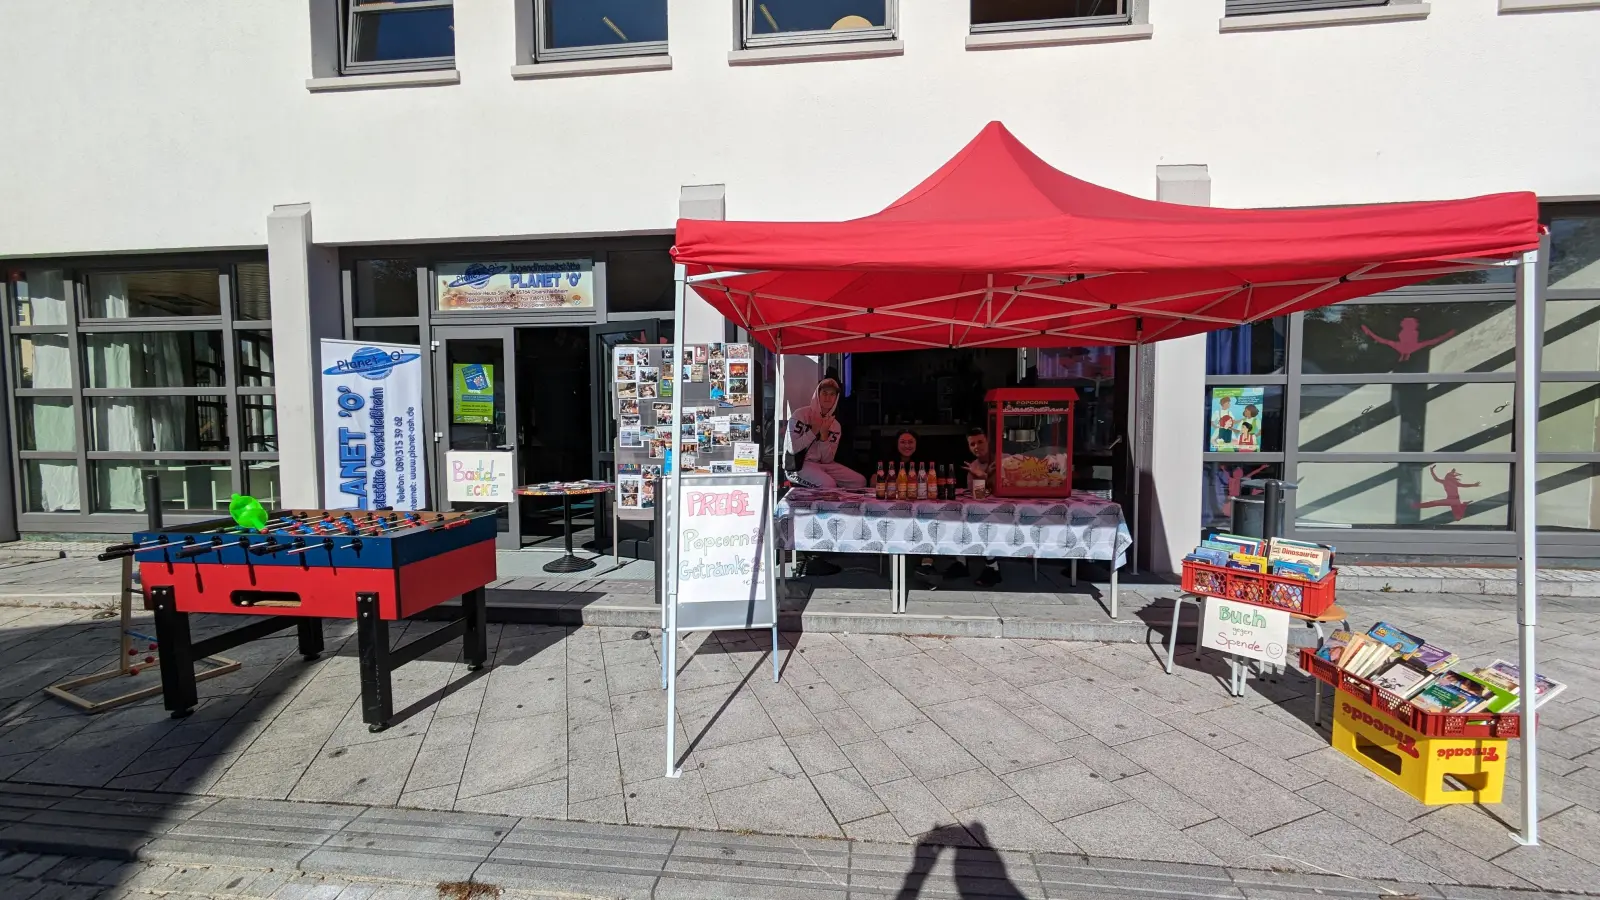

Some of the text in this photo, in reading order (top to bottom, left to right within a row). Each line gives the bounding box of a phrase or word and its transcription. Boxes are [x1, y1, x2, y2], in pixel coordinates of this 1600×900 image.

[509, 273, 562, 289] PLANET
[336, 357, 379, 371] Planet
[369, 386, 386, 467] Oberschleißheim
[392, 416, 404, 427] 62
[393, 427, 404, 439] 39
[338, 426, 367, 511] LANET
[371, 469, 387, 509] eitstätte
[395, 473, 406, 504] Telefon:
[408, 481, 418, 510] nternet:
[466, 484, 499, 497] ECKE
[686, 489, 755, 517] PREISE
[682, 528, 750, 557] Popcorn
[1281, 547, 1320, 559] Dinosaurier
[679, 554, 750, 581] Getränke
[1218, 605, 1267, 629] Buch
[1215, 631, 1264, 652] Spende
[1232, 627, 1254, 637] gegen
[1436, 746, 1500, 763] Frucade
